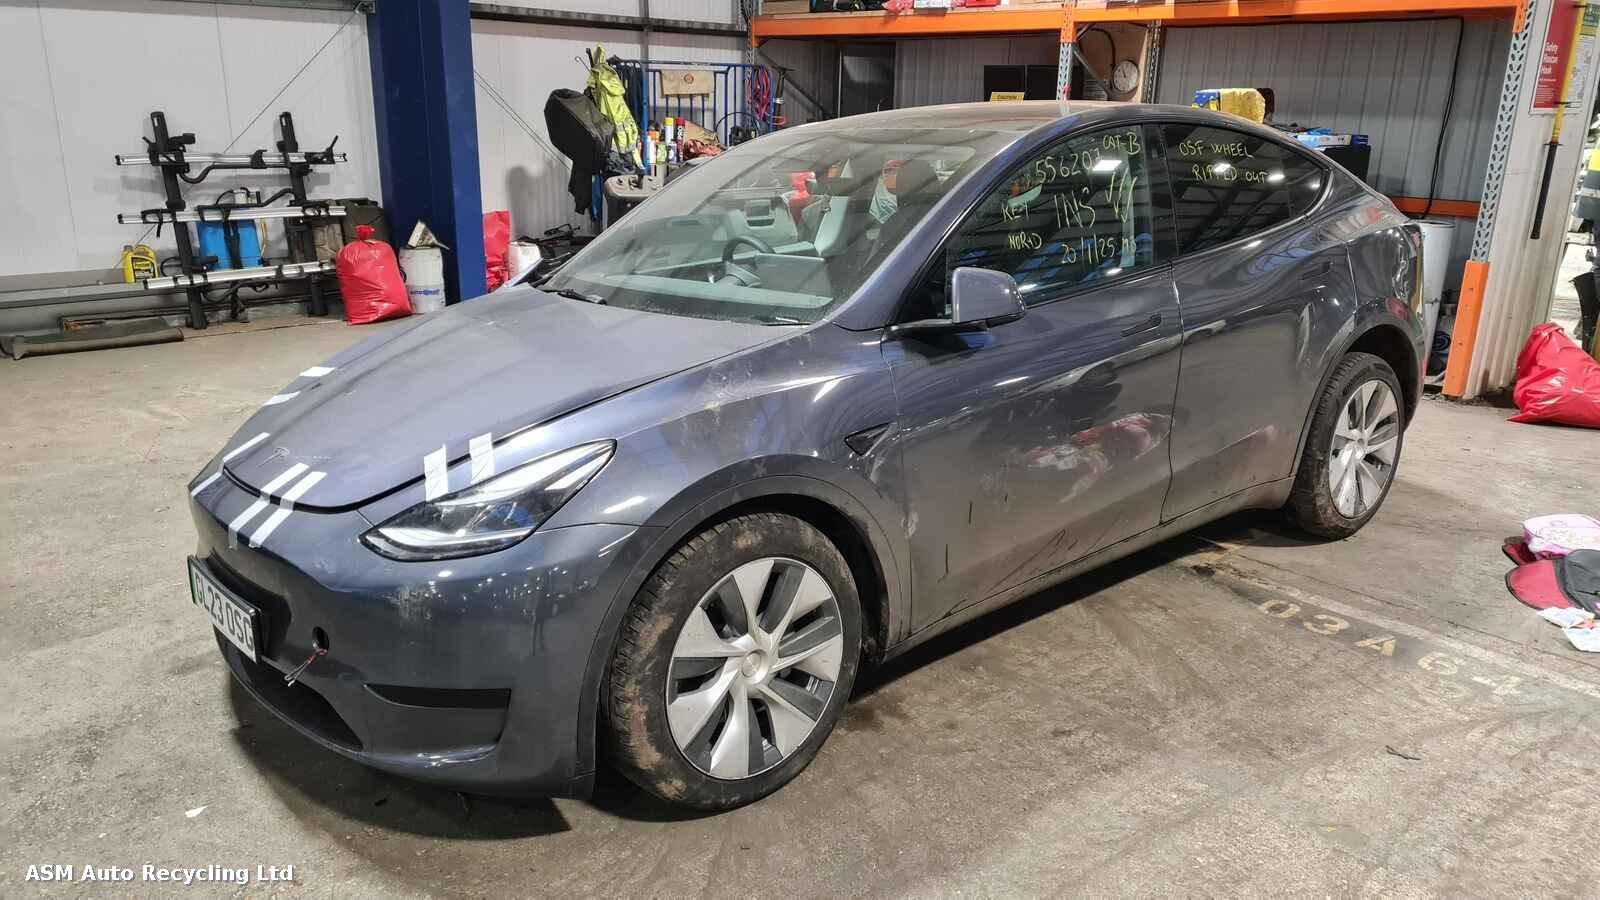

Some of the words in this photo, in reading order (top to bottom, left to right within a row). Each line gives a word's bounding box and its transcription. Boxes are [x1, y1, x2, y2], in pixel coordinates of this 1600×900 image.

[1103, 132, 1141, 155] CAT-B
[1179, 140, 1204, 156] OSF
[1211, 142, 1255, 159] WHEEL
[1245, 171, 1268, 184] OUT
[195, 572, 225, 627] GL23
[226, 601, 254, 652] OSG
